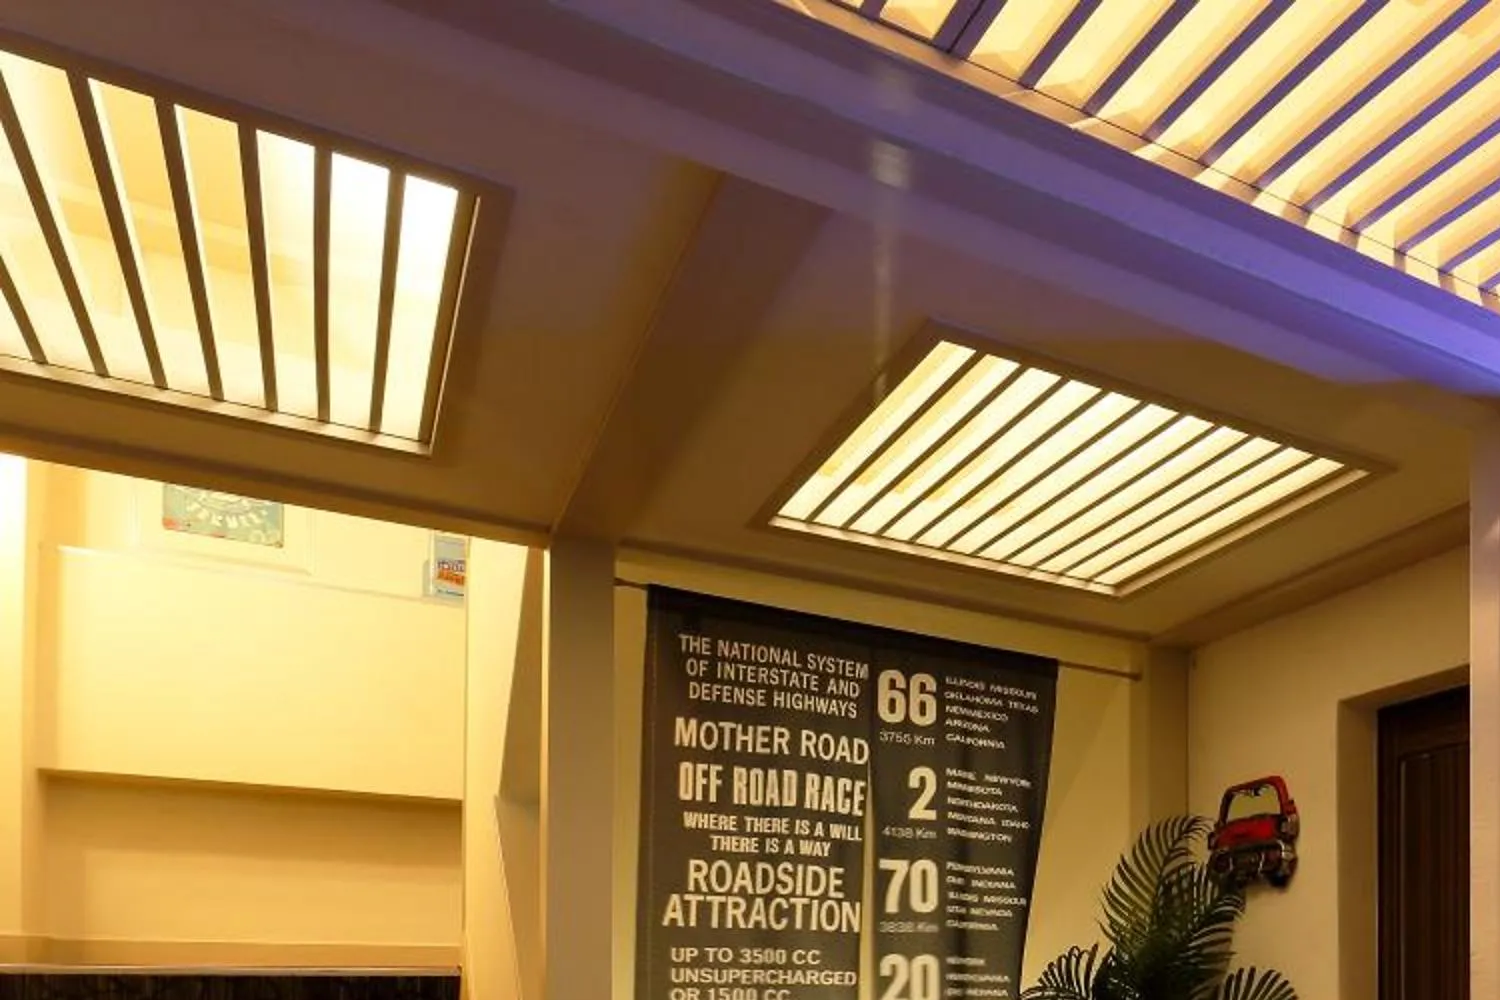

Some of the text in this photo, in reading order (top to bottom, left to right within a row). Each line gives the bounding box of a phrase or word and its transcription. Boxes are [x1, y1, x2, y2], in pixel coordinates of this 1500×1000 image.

[679, 633, 870, 679] THE NATIONAL SYSTEM
[686, 657, 860, 698] OF INTERSTATE AND
[877, 669, 937, 726] 66
[689, 681, 857, 719] DEFENSE HIGHWAYS
[675, 717, 870, 765] MOTHER ROAD
[679, 761, 866, 816] OFF ROAD RACE
[908, 767, 937, 821] 2
[683, 811, 862, 841] WHERE THERE IS A WILL
[710, 835, 831, 857] THERE IS A WAY
[687, 860, 845, 899] ROADSIDE
[878, 859, 939, 914] 70
[662, 894, 861, 933] ATTRACTION
[671, 948, 821, 964] UP TO 3500 CC
[671, 968, 857, 986] UNSUPERCHARGED
